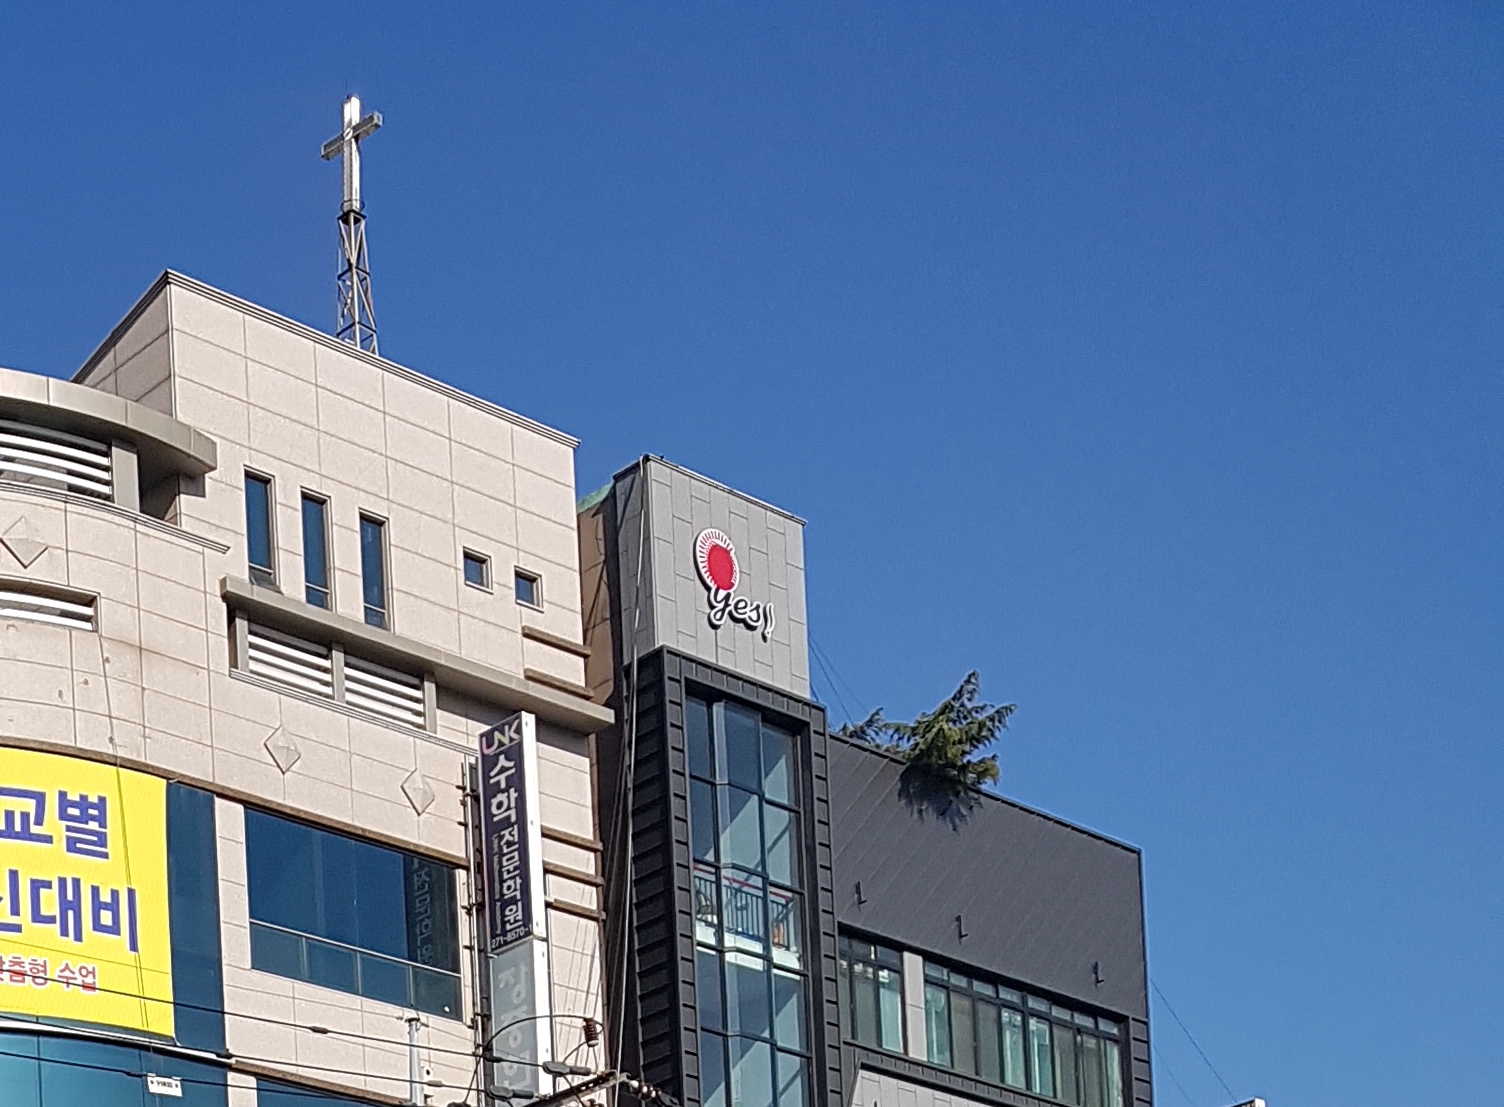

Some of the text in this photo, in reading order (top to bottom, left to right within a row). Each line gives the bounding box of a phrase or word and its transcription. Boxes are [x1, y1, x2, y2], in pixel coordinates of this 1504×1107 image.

[481, 719, 521, 755] UNK
[489, 754, 519, 823] 수학
[499, 825, 523, 932] 전문학원
[57, 961, 97, 992] 수업
